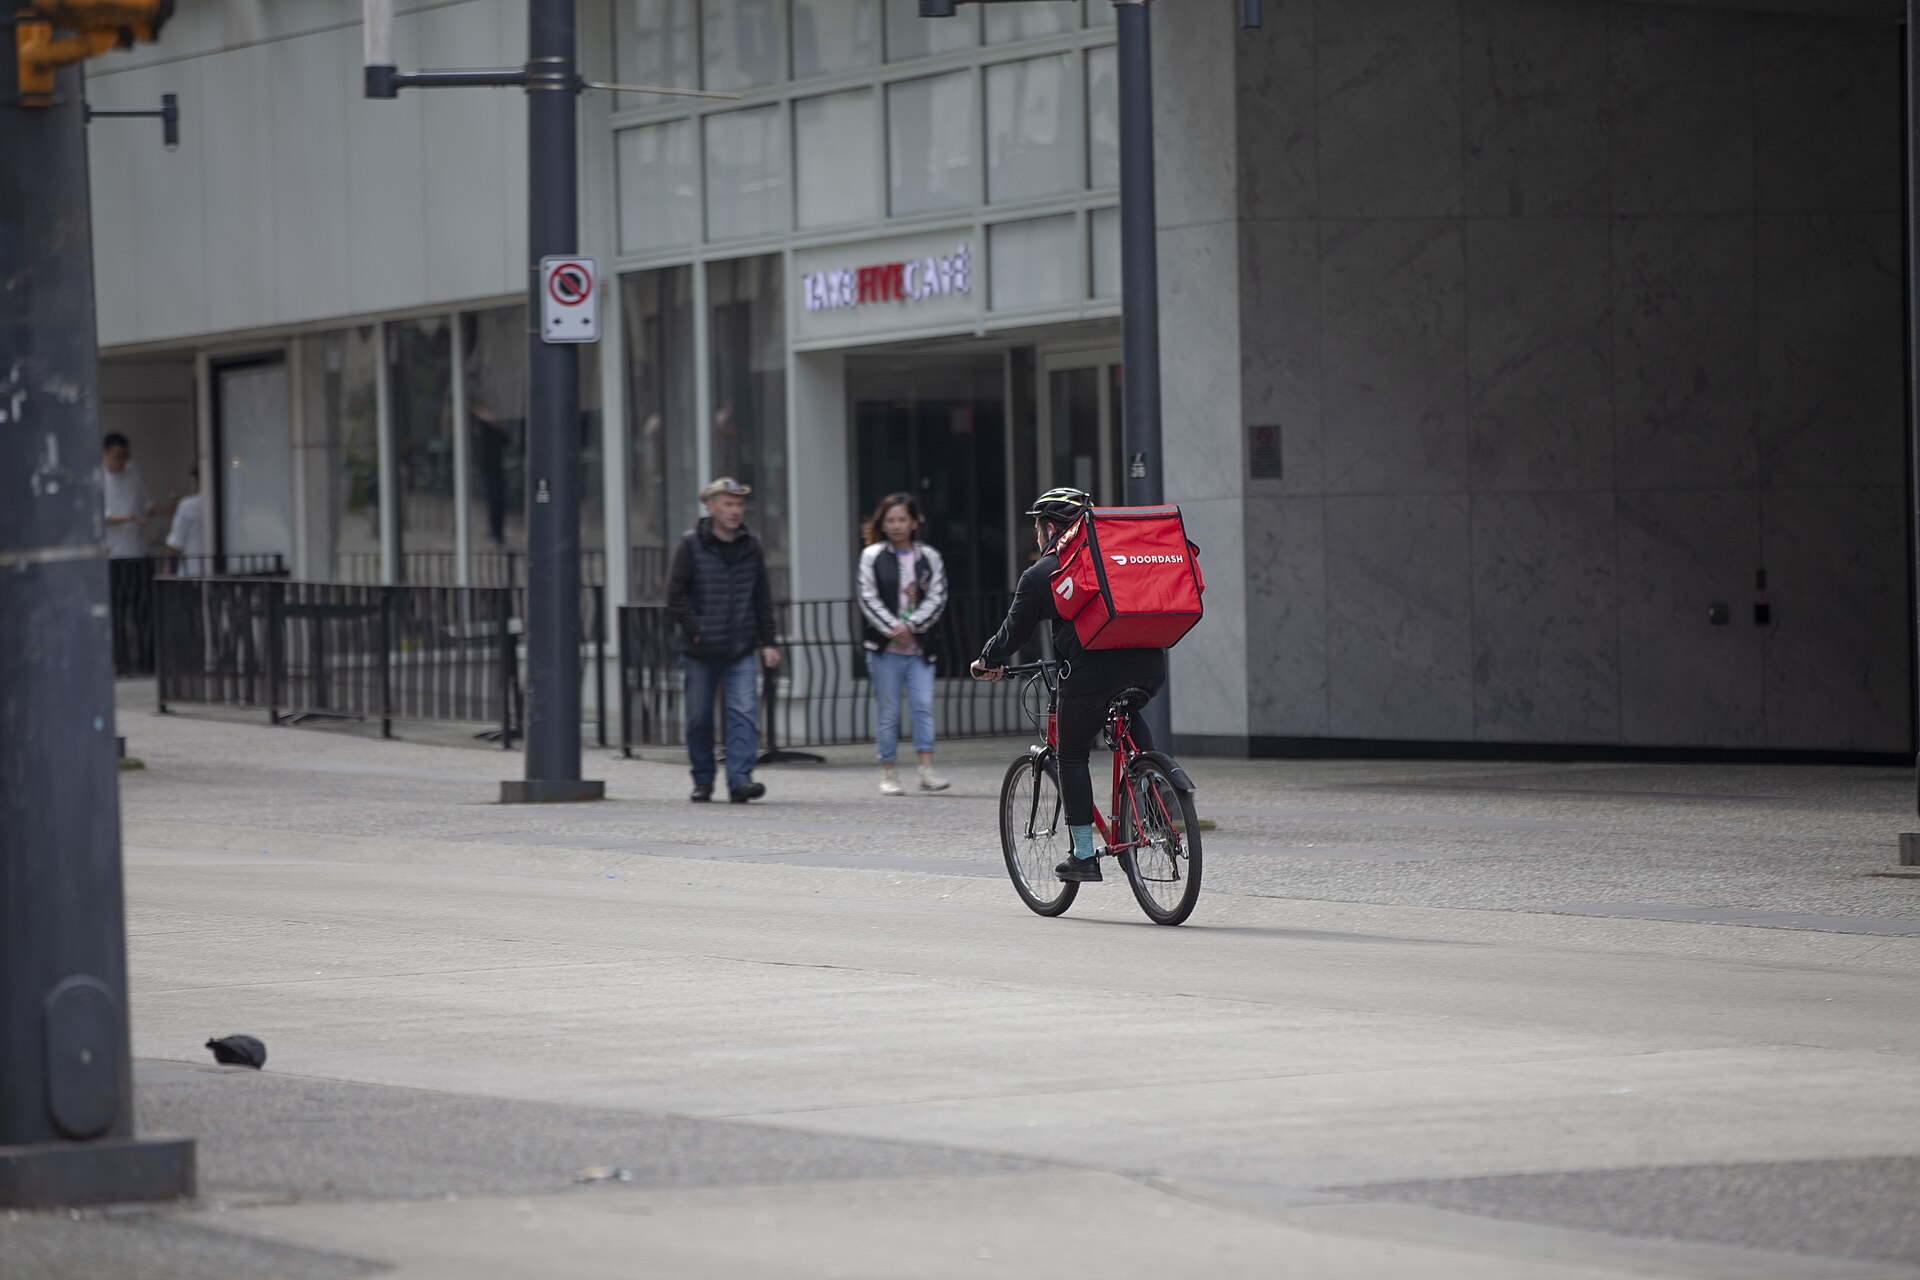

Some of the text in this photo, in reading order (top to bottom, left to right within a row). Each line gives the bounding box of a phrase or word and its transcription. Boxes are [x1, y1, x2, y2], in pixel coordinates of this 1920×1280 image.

[803, 267, 857, 311] TAKE
[857, 262, 904, 304] FIVE
[1129, 555, 1184, 565] DOORDASH
